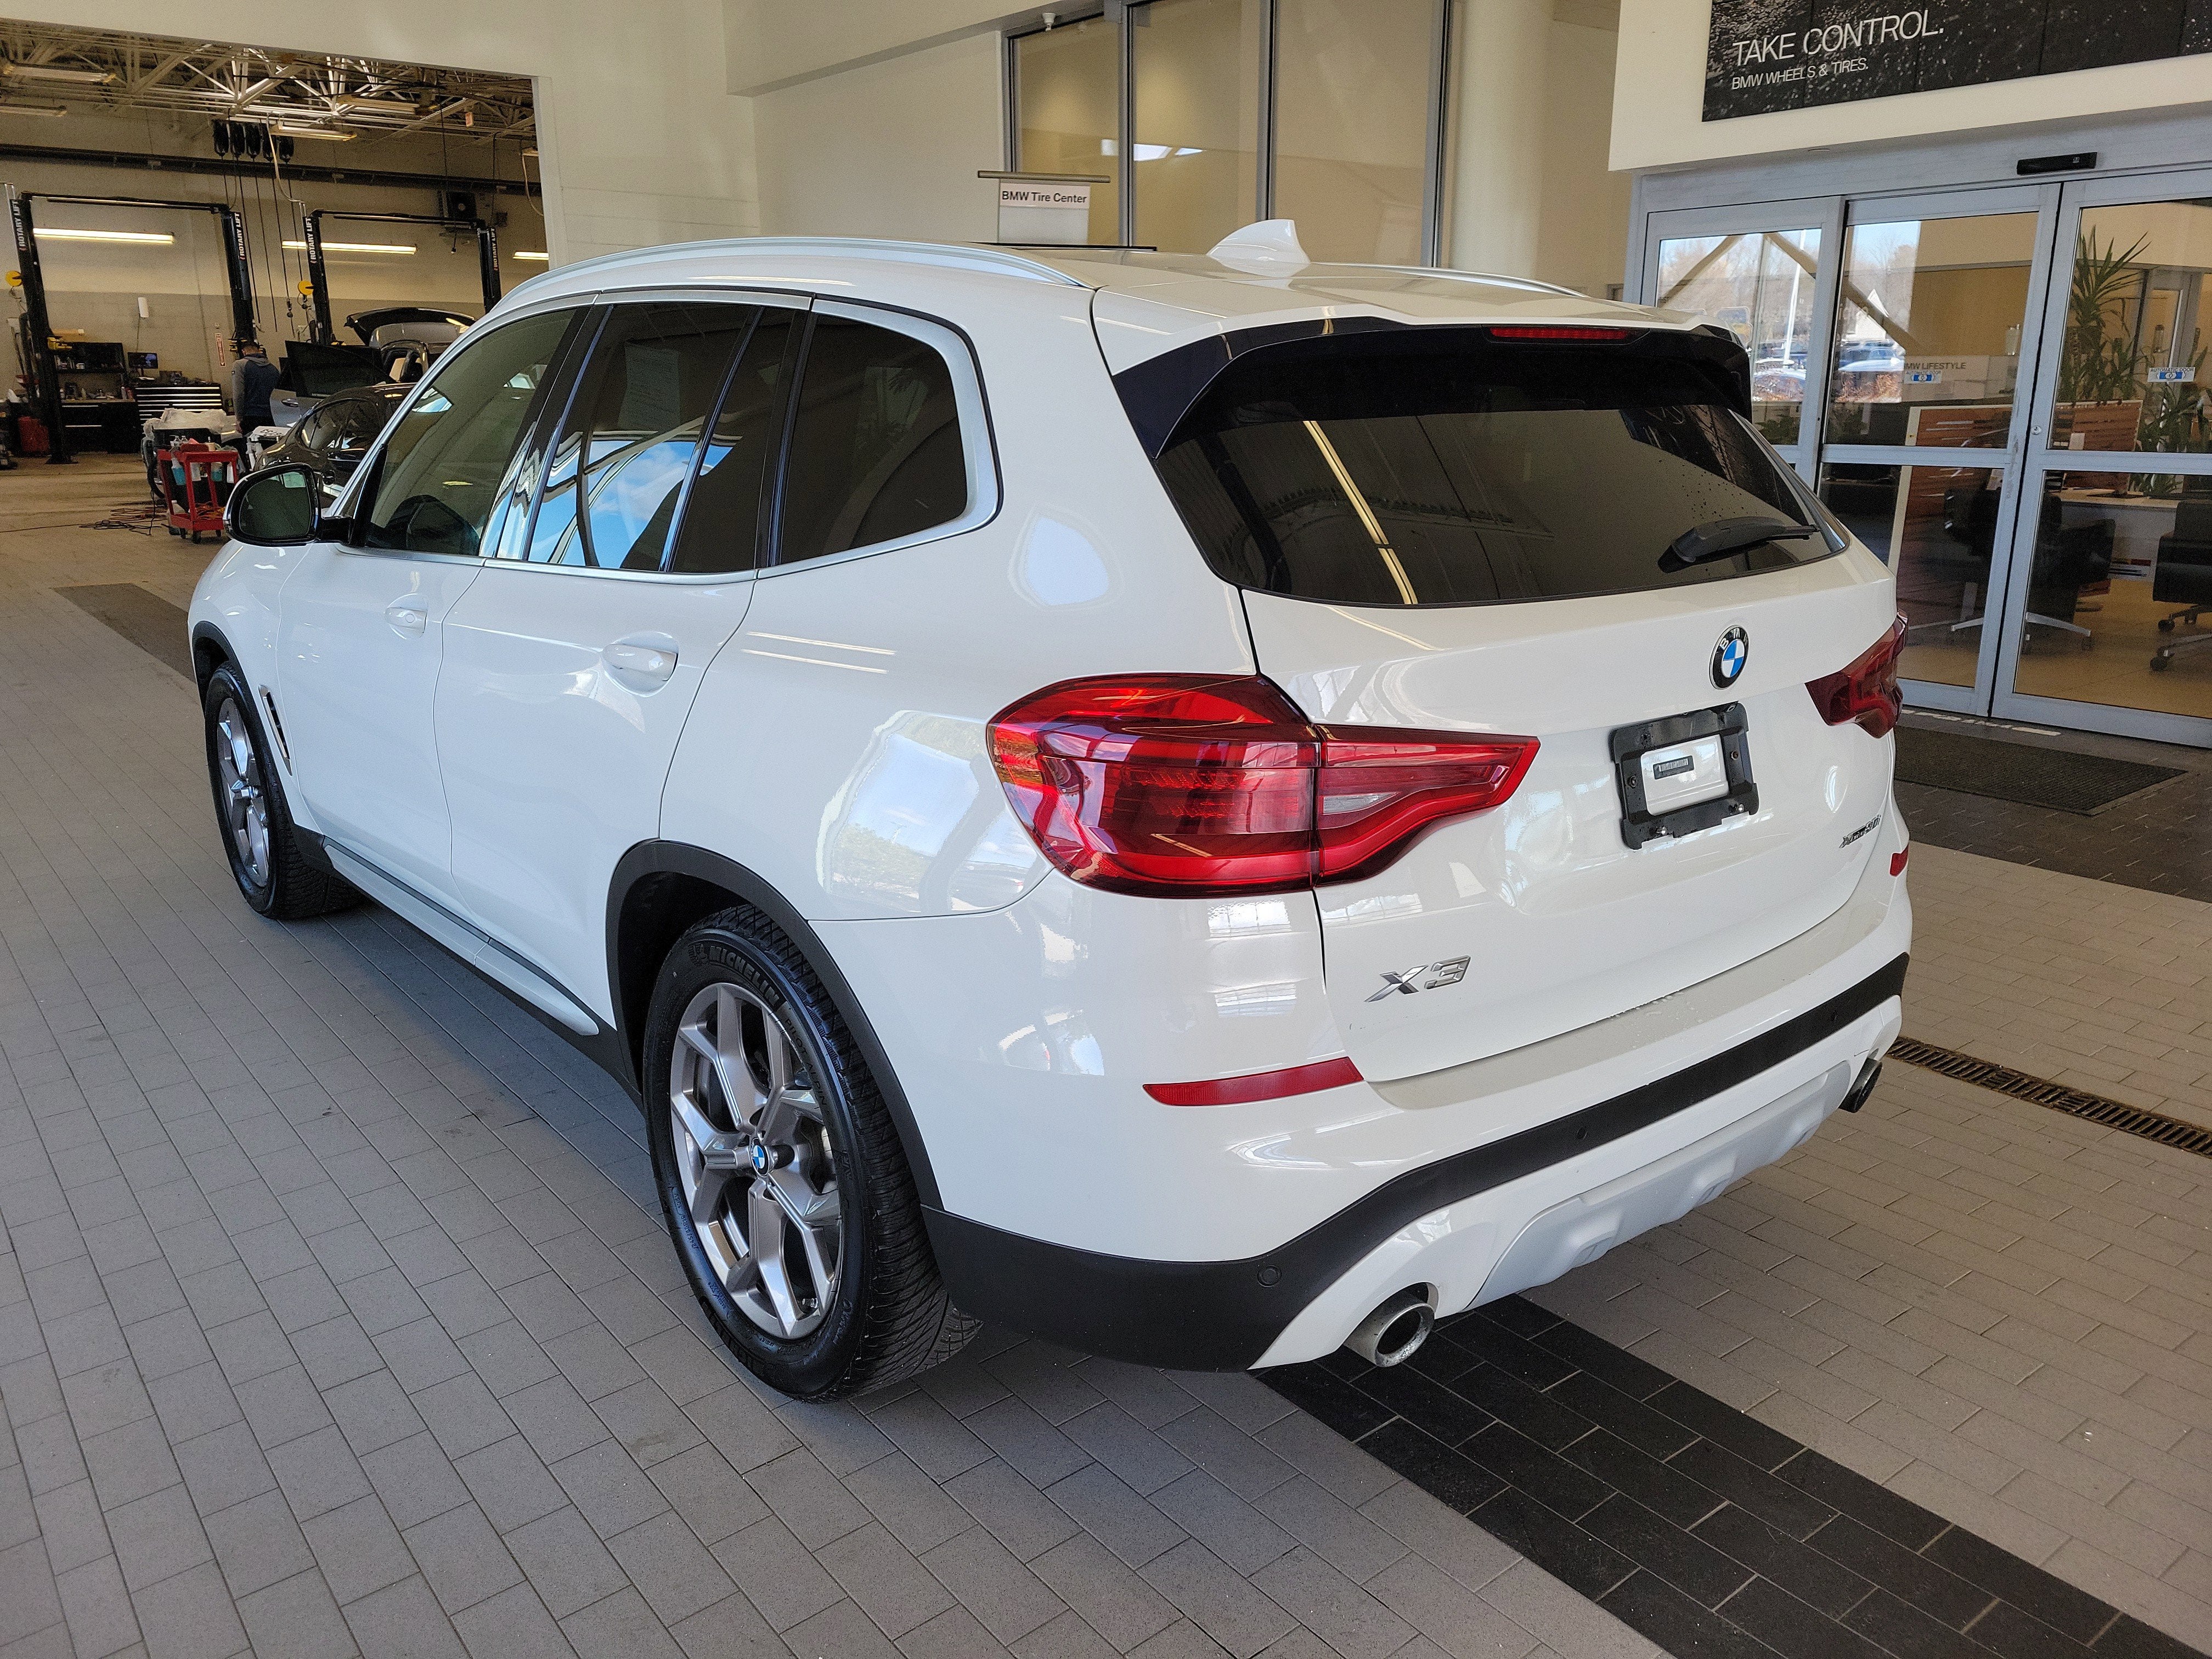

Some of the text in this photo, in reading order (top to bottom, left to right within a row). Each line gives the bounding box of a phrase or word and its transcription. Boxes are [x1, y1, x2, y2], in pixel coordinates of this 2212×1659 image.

[1732, 9, 1944, 66] TAKE CONTROL.
[1732, 58, 1869, 90] BMW WHEELS & TIRES.
[1002, 191, 1087, 203] BMW Tire Center
[14, 217, 26, 247] ROTARY
[236, 229, 245, 256] ROTARY
[307, 233, 316, 260] ROTARY
[709, 945, 780, 1006] MICHELIN
[1364, 955, 1471, 1003] X3
[784, 1018, 808, 1056] PILOT
